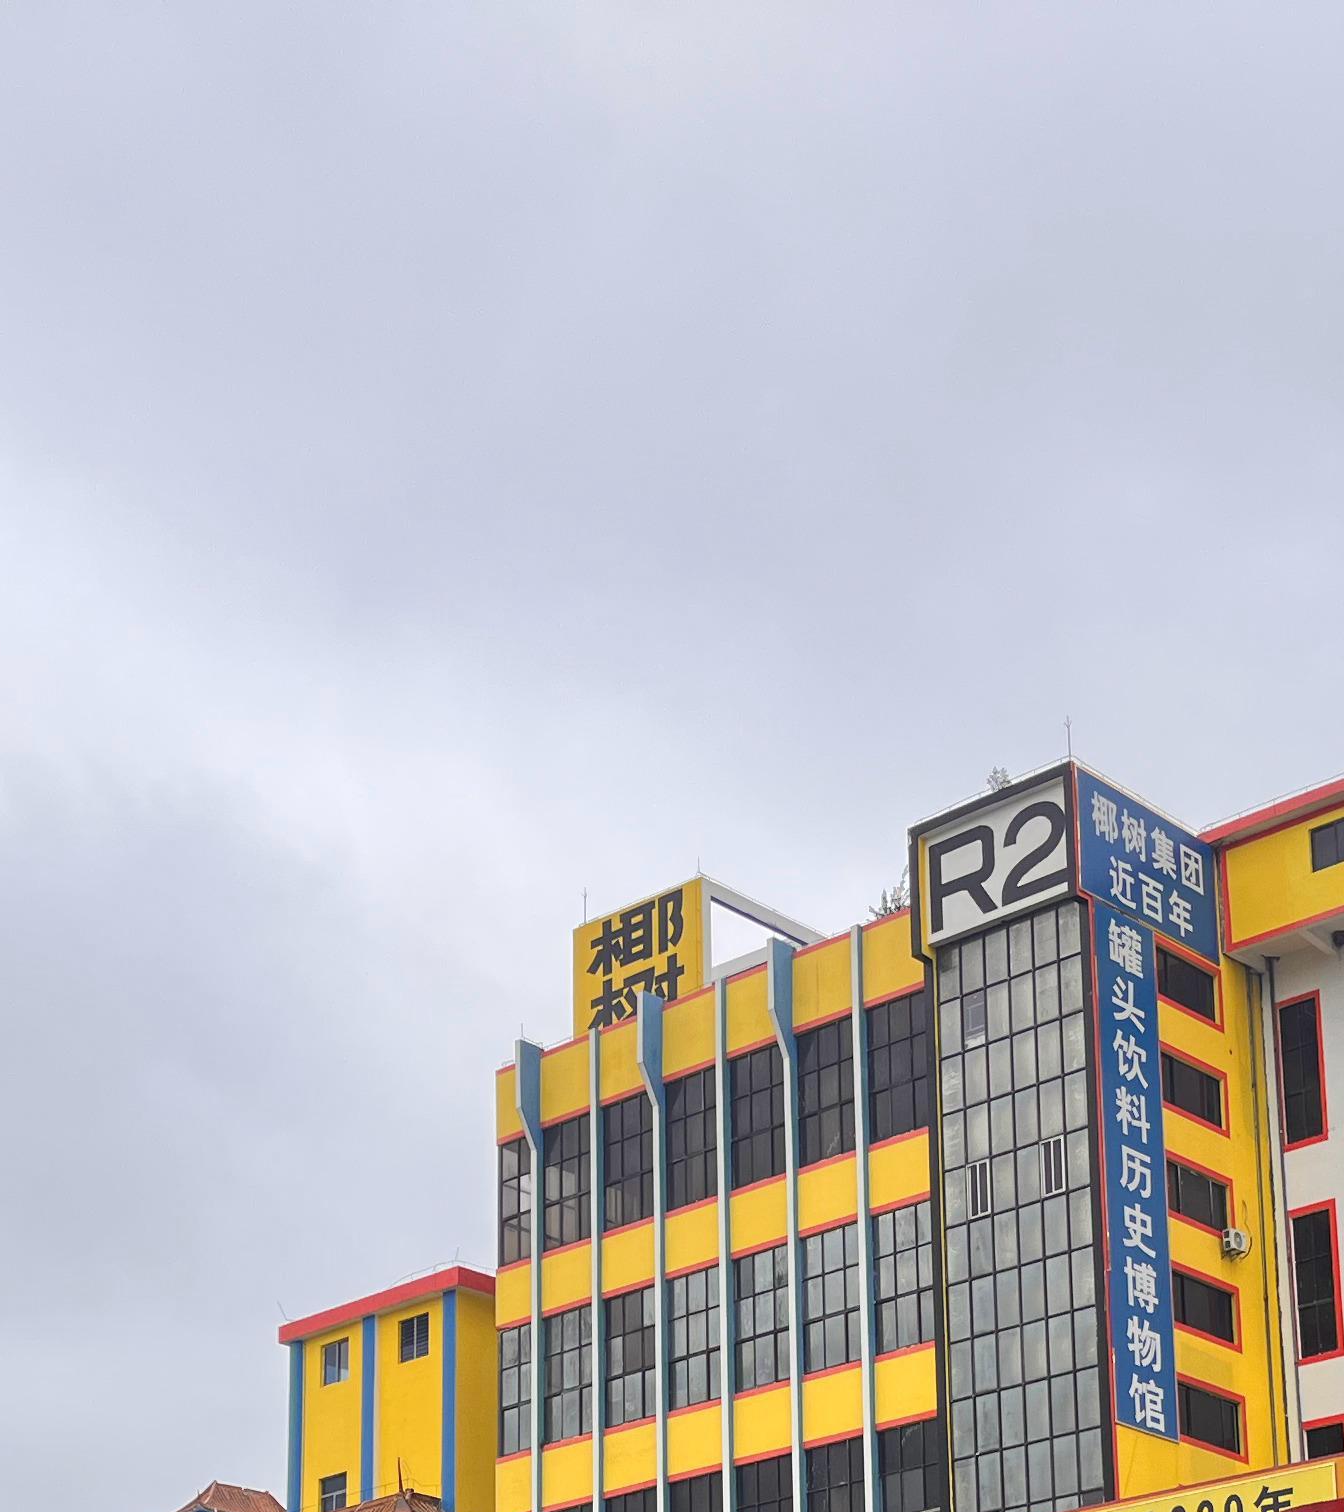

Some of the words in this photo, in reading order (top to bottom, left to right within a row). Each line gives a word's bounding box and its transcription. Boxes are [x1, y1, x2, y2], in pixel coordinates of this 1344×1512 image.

[928, 801, 1068, 934] R2
[1091, 790, 1205, 897] 椰树集团
[1108, 856, 1194, 938] 近百年
[1107, 918, 1166, 1432] 罐头饮料历史博物馆
